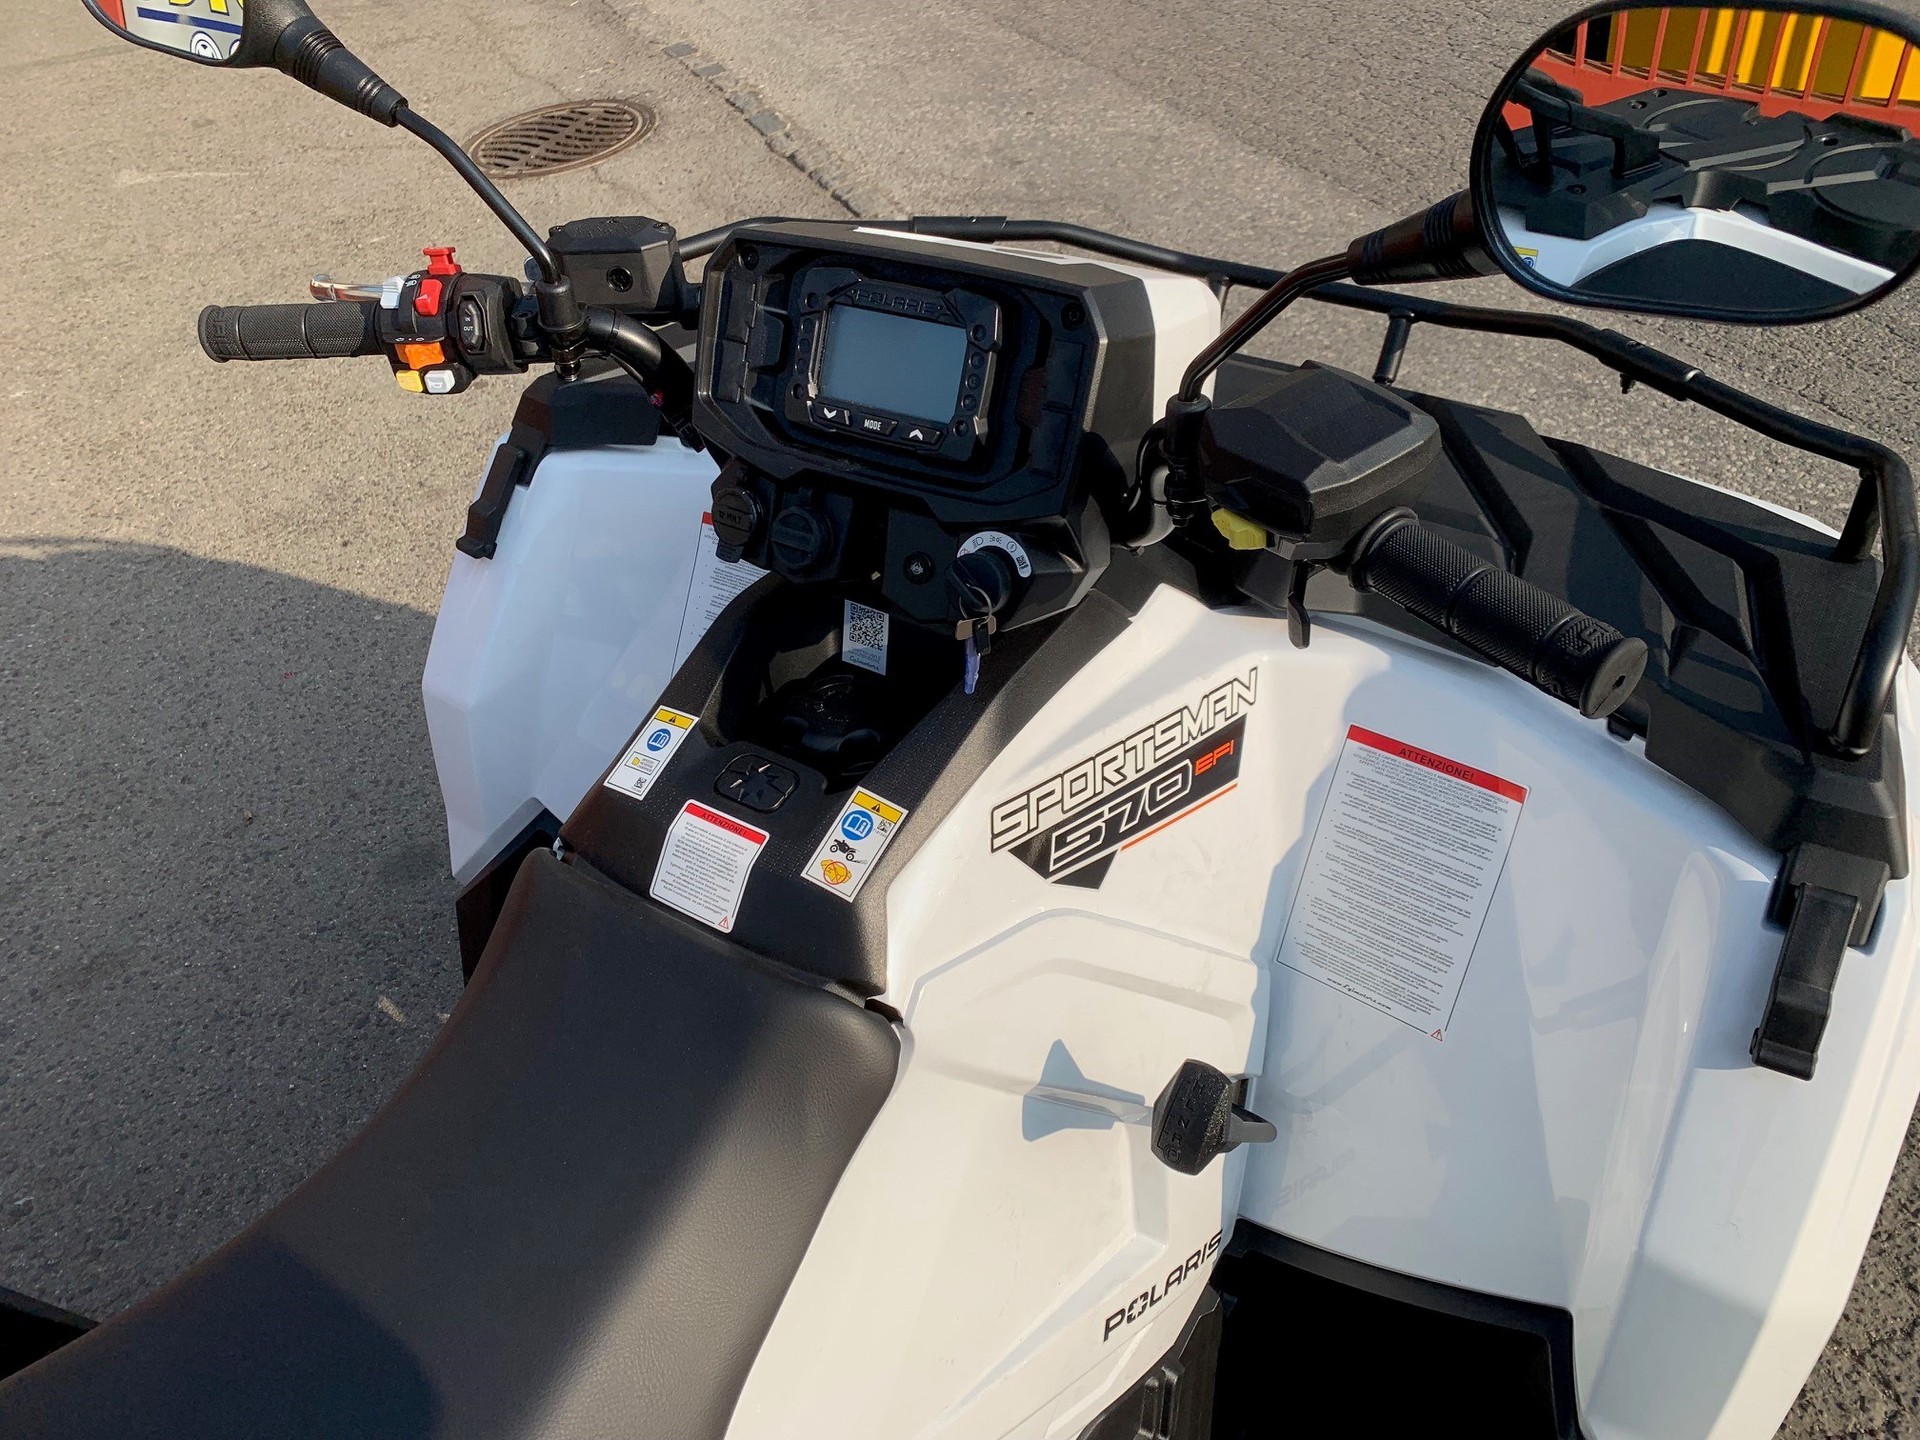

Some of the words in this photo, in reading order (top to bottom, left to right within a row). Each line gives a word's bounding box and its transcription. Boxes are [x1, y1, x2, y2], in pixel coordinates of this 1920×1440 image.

[863, 417, 883, 432] MODE
[990, 665, 1259, 853] SPORTSMAN
[1397, 746, 1476, 781] ATTENZIONE!
[1049, 758, 1193, 872] 570
[1194, 740, 1236, 777] EFI
[700, 811, 749, 837] ATTENZIONE!
[1177, 1118, 1190, 1129] N
[1171, 1132, 1183, 1146] R
[1103, 1228, 1223, 1342] POLARIS
